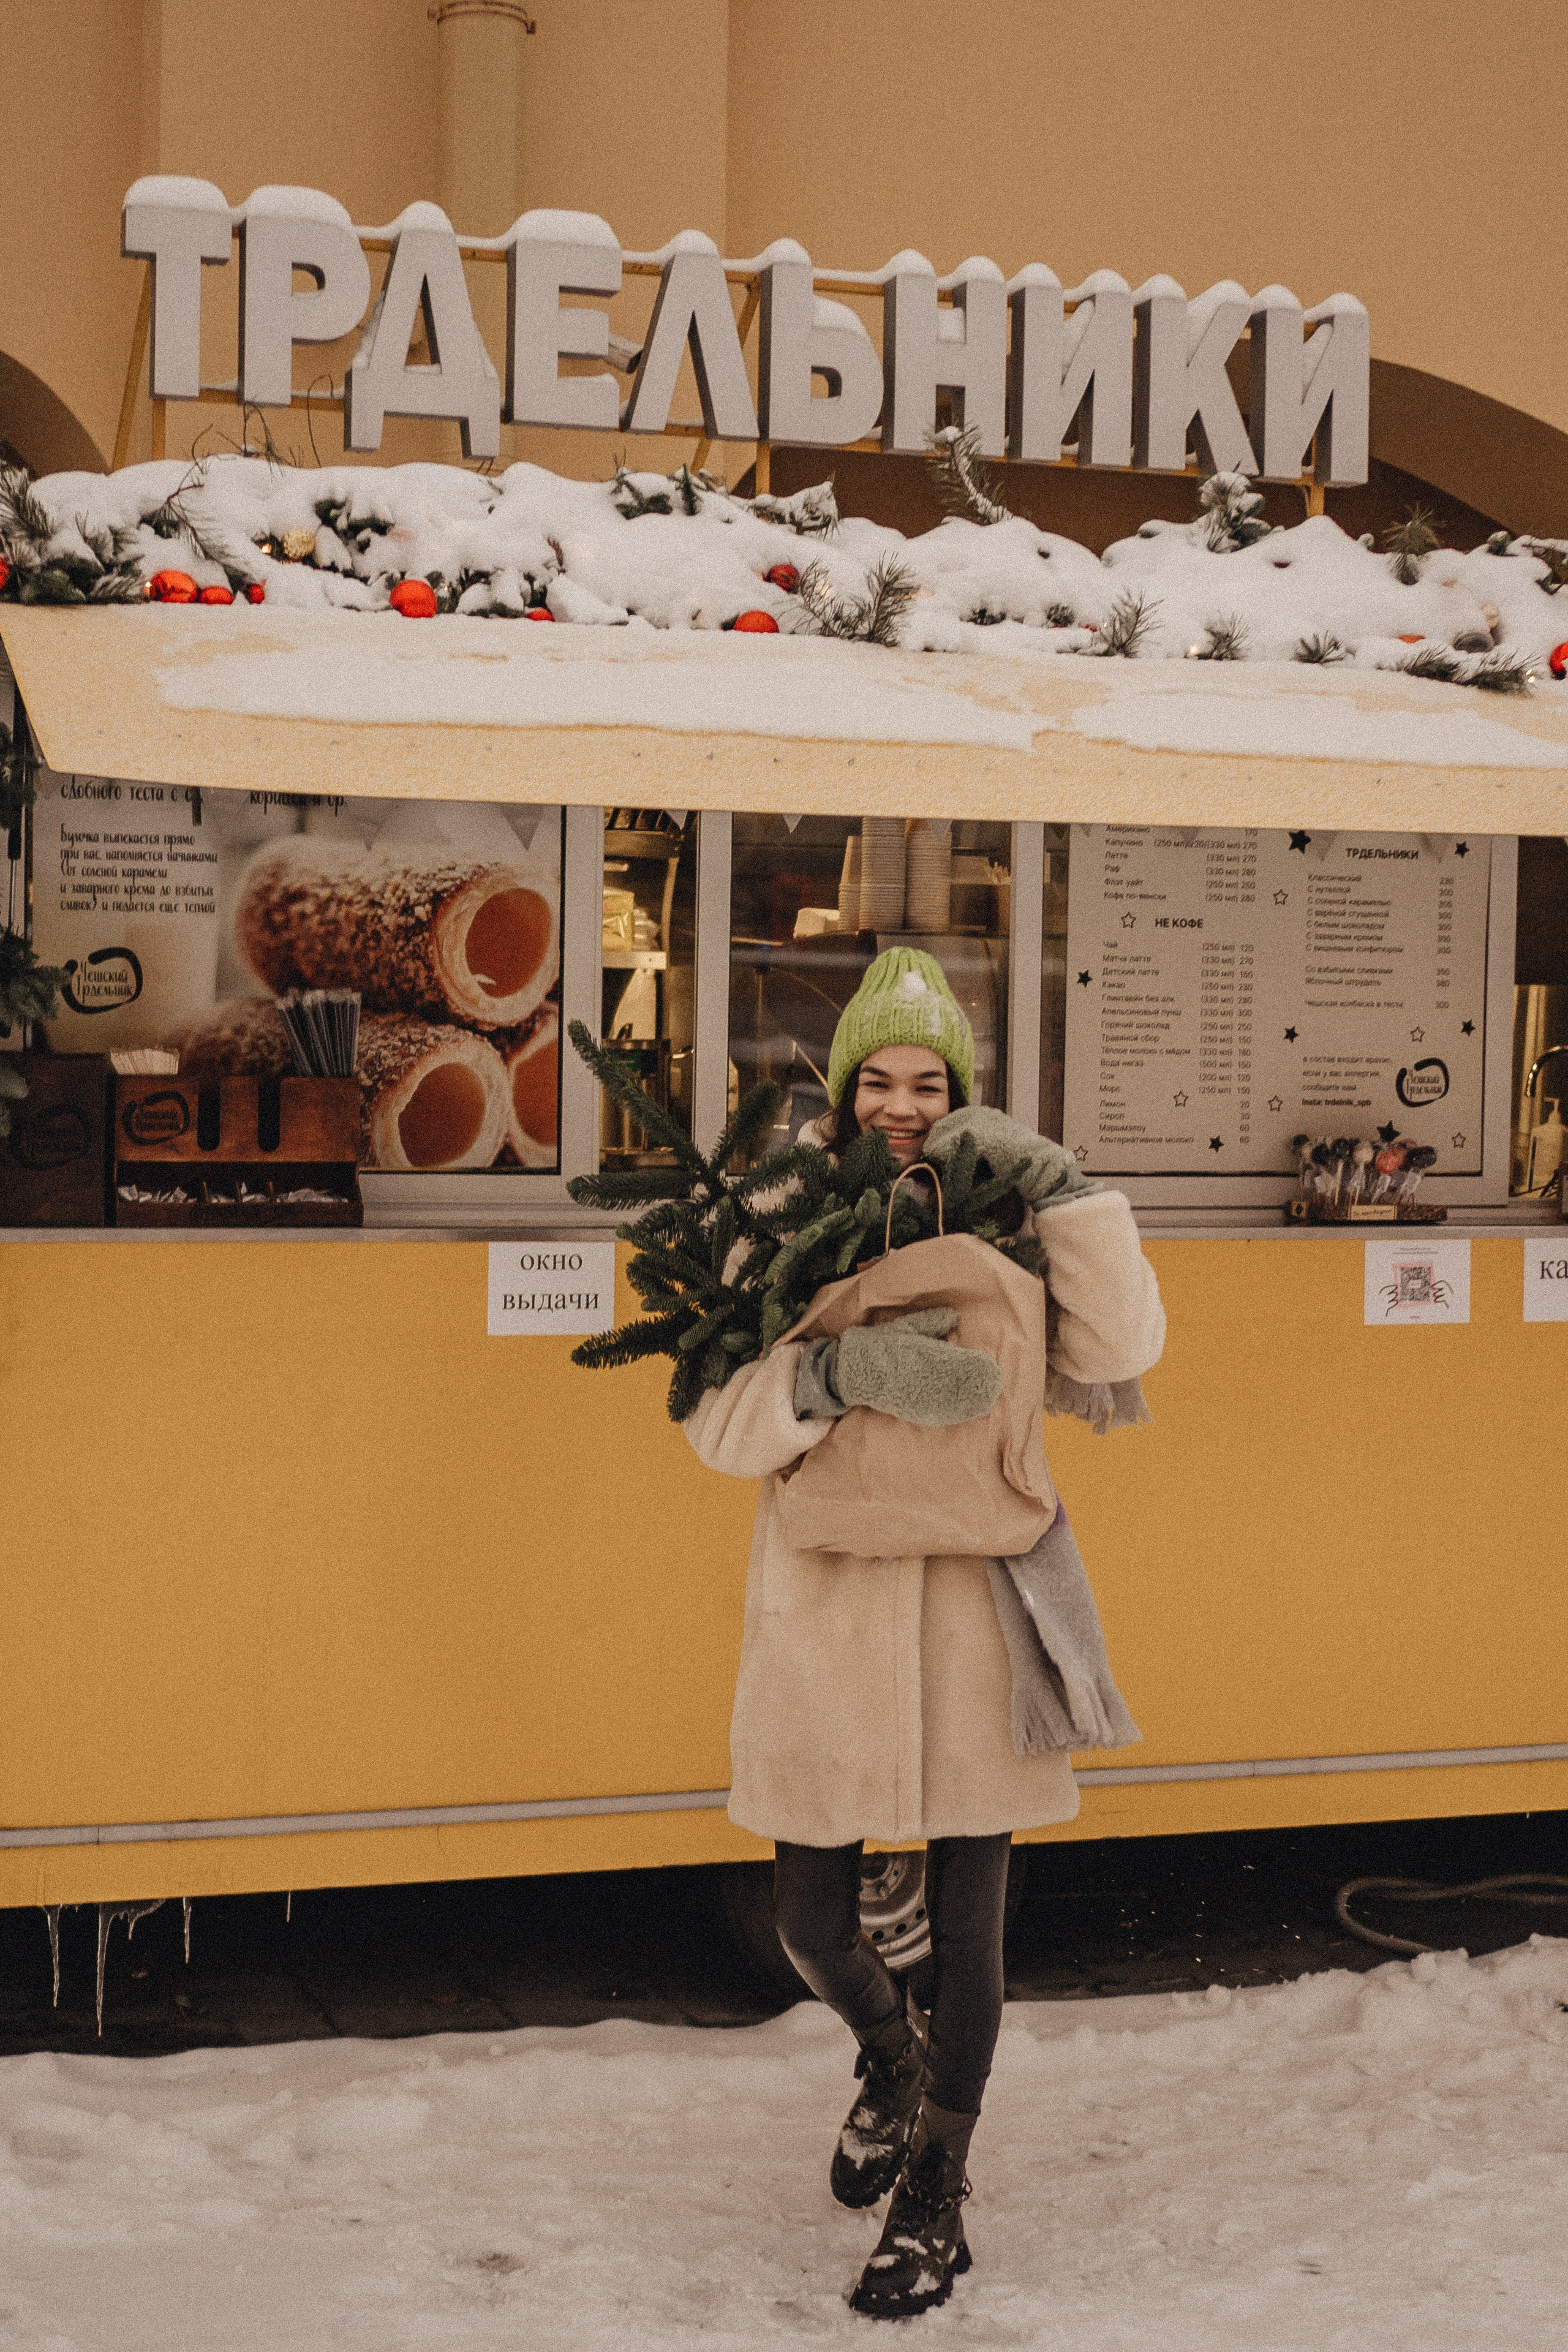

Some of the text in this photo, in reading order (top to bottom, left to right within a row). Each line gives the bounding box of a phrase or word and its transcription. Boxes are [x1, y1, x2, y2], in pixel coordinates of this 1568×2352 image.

[124, 202, 1370, 486] ТРДЕЛЬНИКИ
[61, 775, 121, 800] сдобного
[130, 786, 164, 801] теста
[61, 824, 195, 852] Булочка выпекается прямо
[60, 849, 79, 865] при
[106, 851, 163, 862] наполняется
[1346, 848, 1419, 859] ТРДЕЛЬНИКИ
[123, 867, 167, 884] карамели
[61, 883, 66, 894] и
[124, 884, 155, 901] крема
[160, 885, 171, 896] до
[175, 884, 214, 896] взбитых
[102, 901, 108, 911] и
[1155, 919, 1203, 929] НЕ КОФЕ
[80, 961, 127, 982] Чешский
[521, 1254, 582, 1271] окно
[503, 1294, 599, 1313] выдачи
